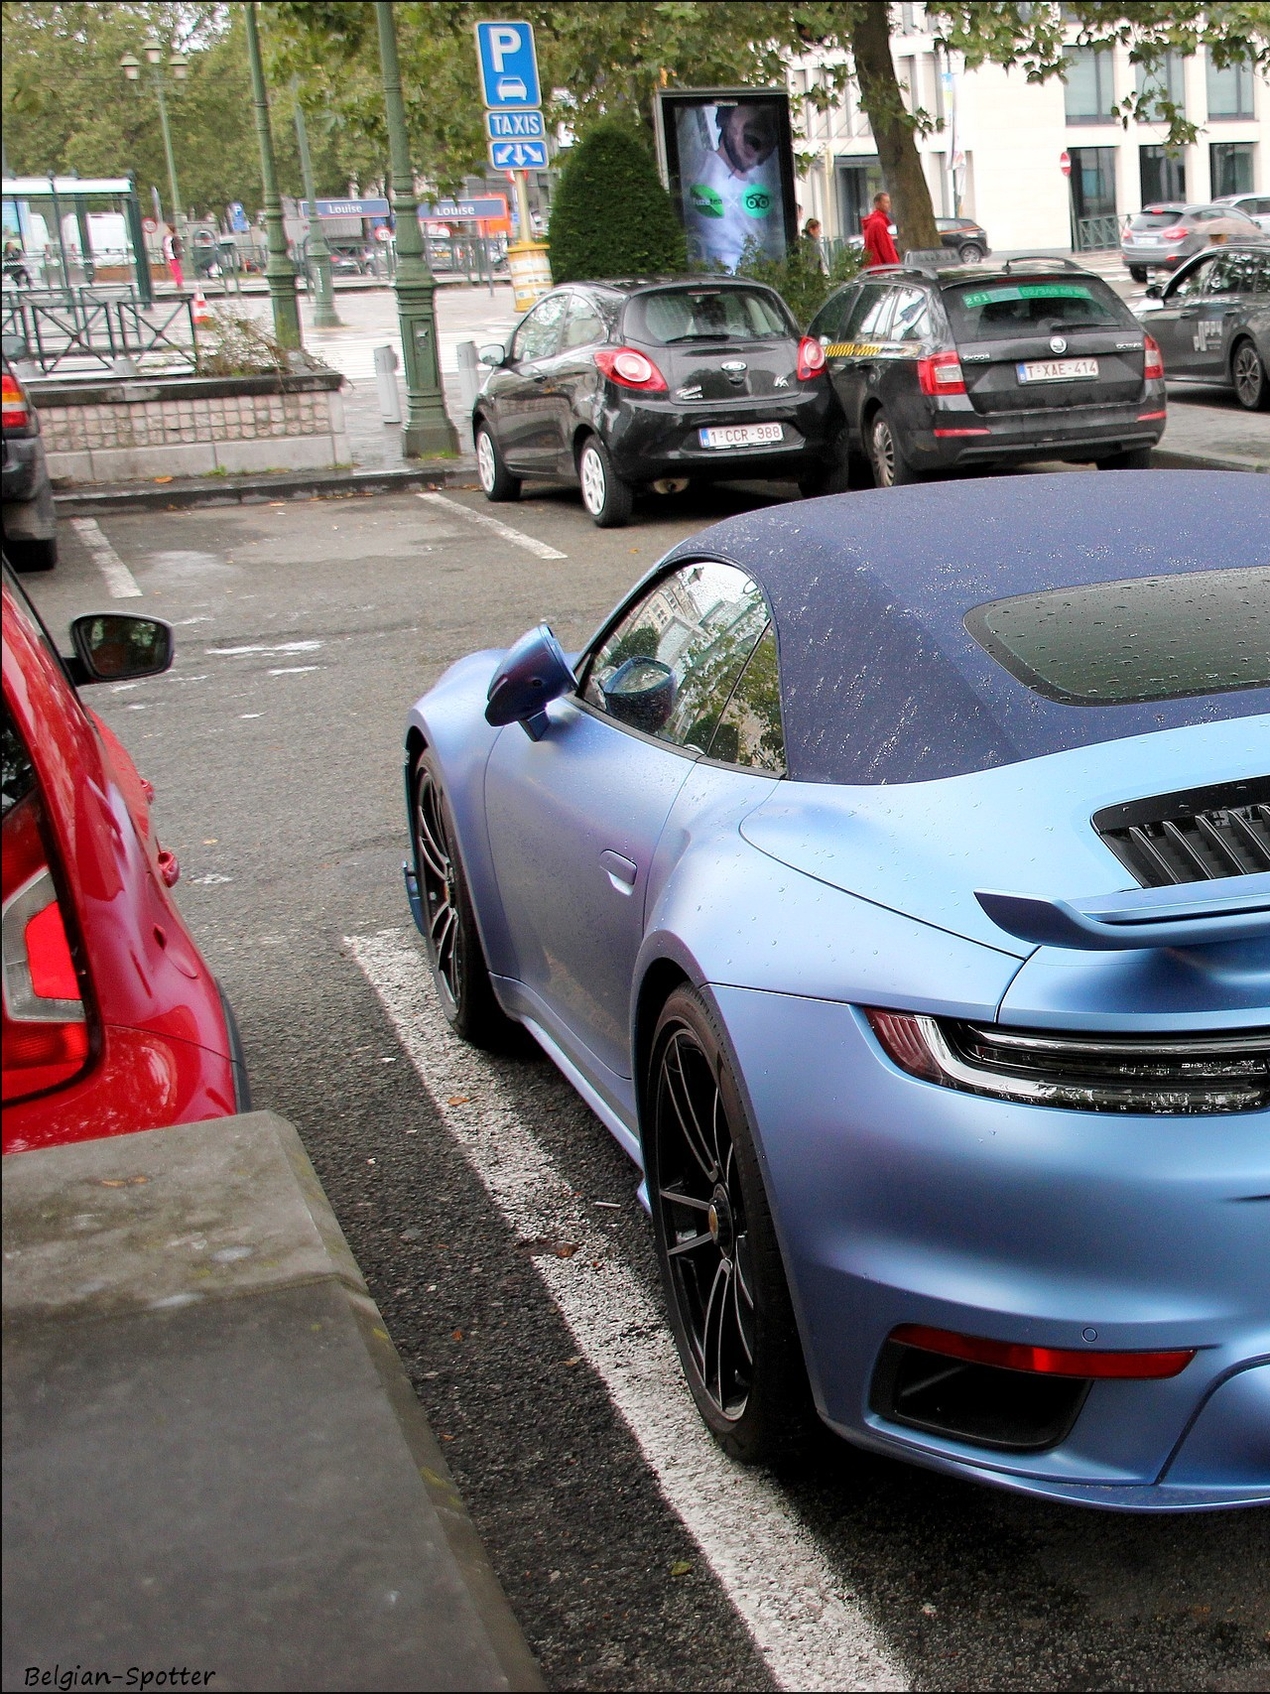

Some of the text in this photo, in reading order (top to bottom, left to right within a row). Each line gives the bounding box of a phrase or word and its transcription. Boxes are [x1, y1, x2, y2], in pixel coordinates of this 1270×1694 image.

[489, 26, 522, 73] P
[492, 115, 540, 135] TAXIS
[329, 202, 362, 215] Louise
[436, 205, 475, 217] Louise
[1026, 361, 1096, 378] T-XAE-414
[711, 427, 780, 443] 1-CCR-988
